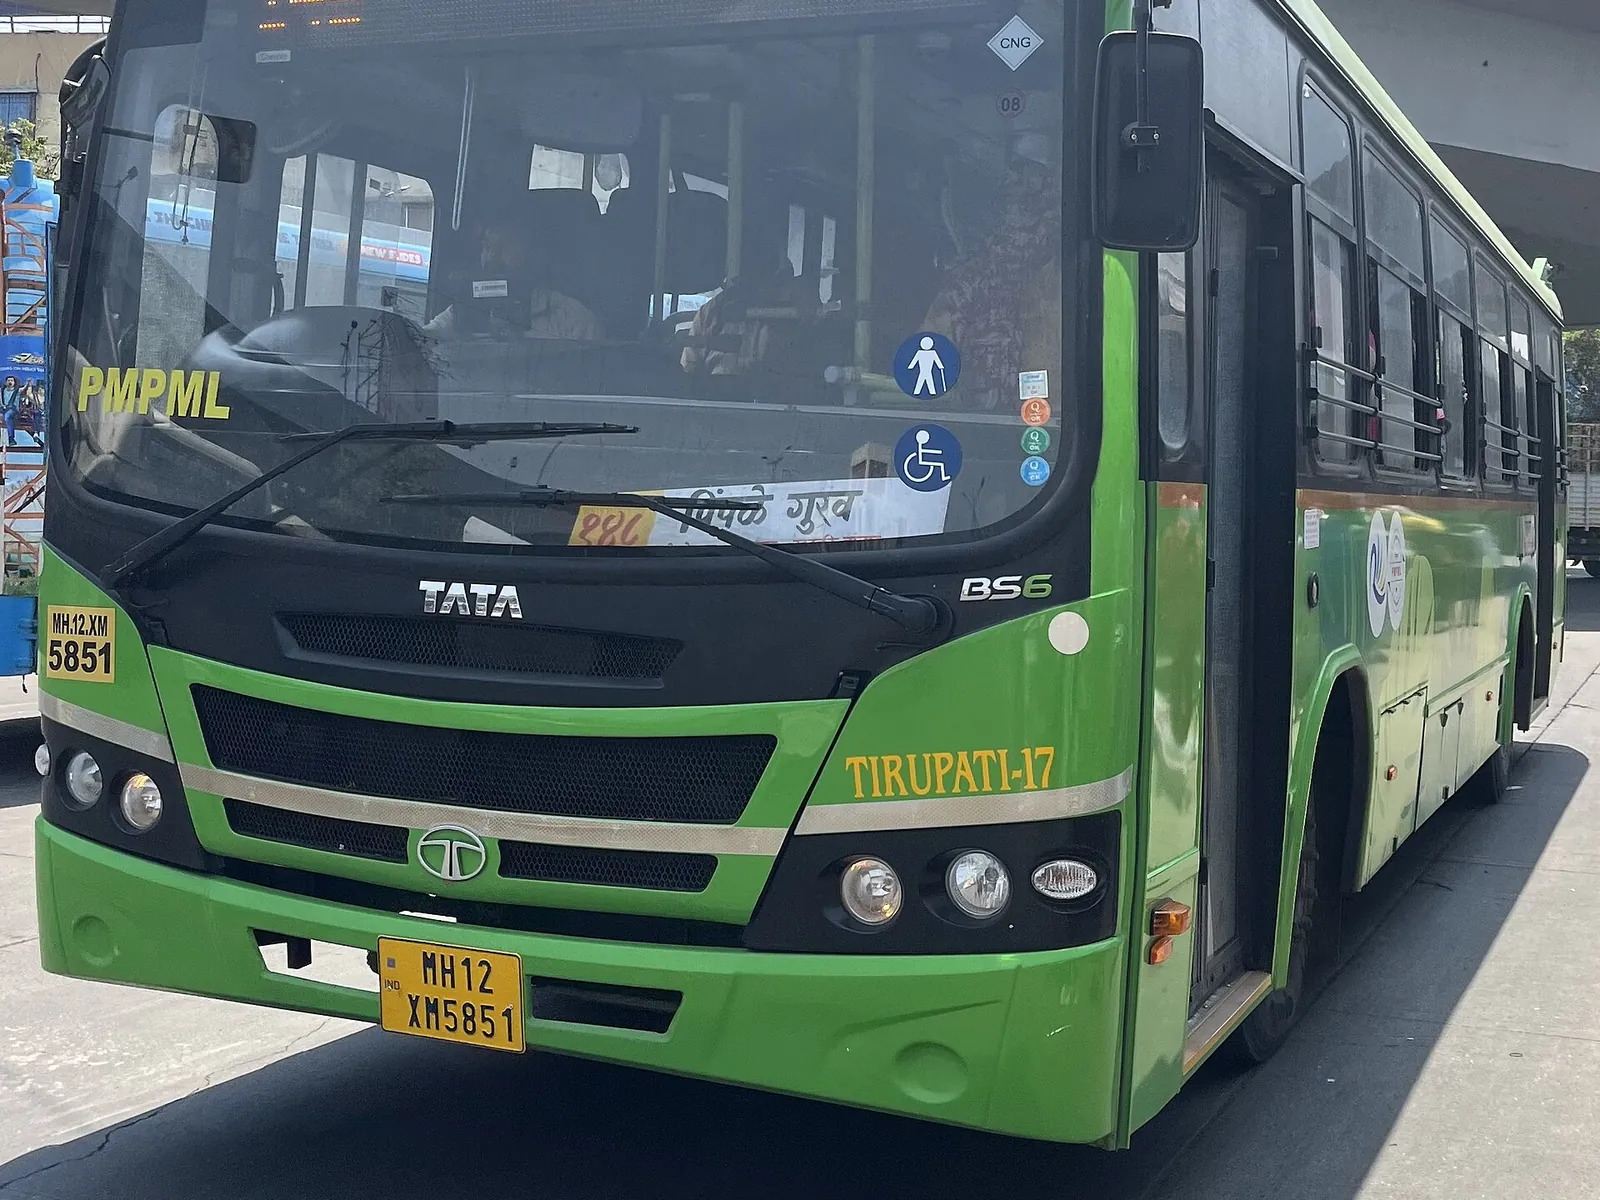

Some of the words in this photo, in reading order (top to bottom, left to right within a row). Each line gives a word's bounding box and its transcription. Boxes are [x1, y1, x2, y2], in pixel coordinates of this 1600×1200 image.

[1000, 36, 1031, 49] CNG
[1001, 97, 1020, 112] 08
[78, 366, 231, 420] PMPML
[1031, 402, 1040, 413] Q
[1030, 431, 1040, 442] Q
[1030, 460, 1039, 471] Q
[786, 490, 864, 535] गुरव
[419, 580, 523, 619] TATA
[959, 574, 1053, 602] BS6
[52, 612, 108, 637] MH.12.XM
[48, 639, 111, 674] 5851
[845, 747, 1055, 799] TIRUPATI-17
[384, 978, 400, 991] IND
[422, 950, 494, 995] MH12
[407, 993, 513, 1043] XM5851
